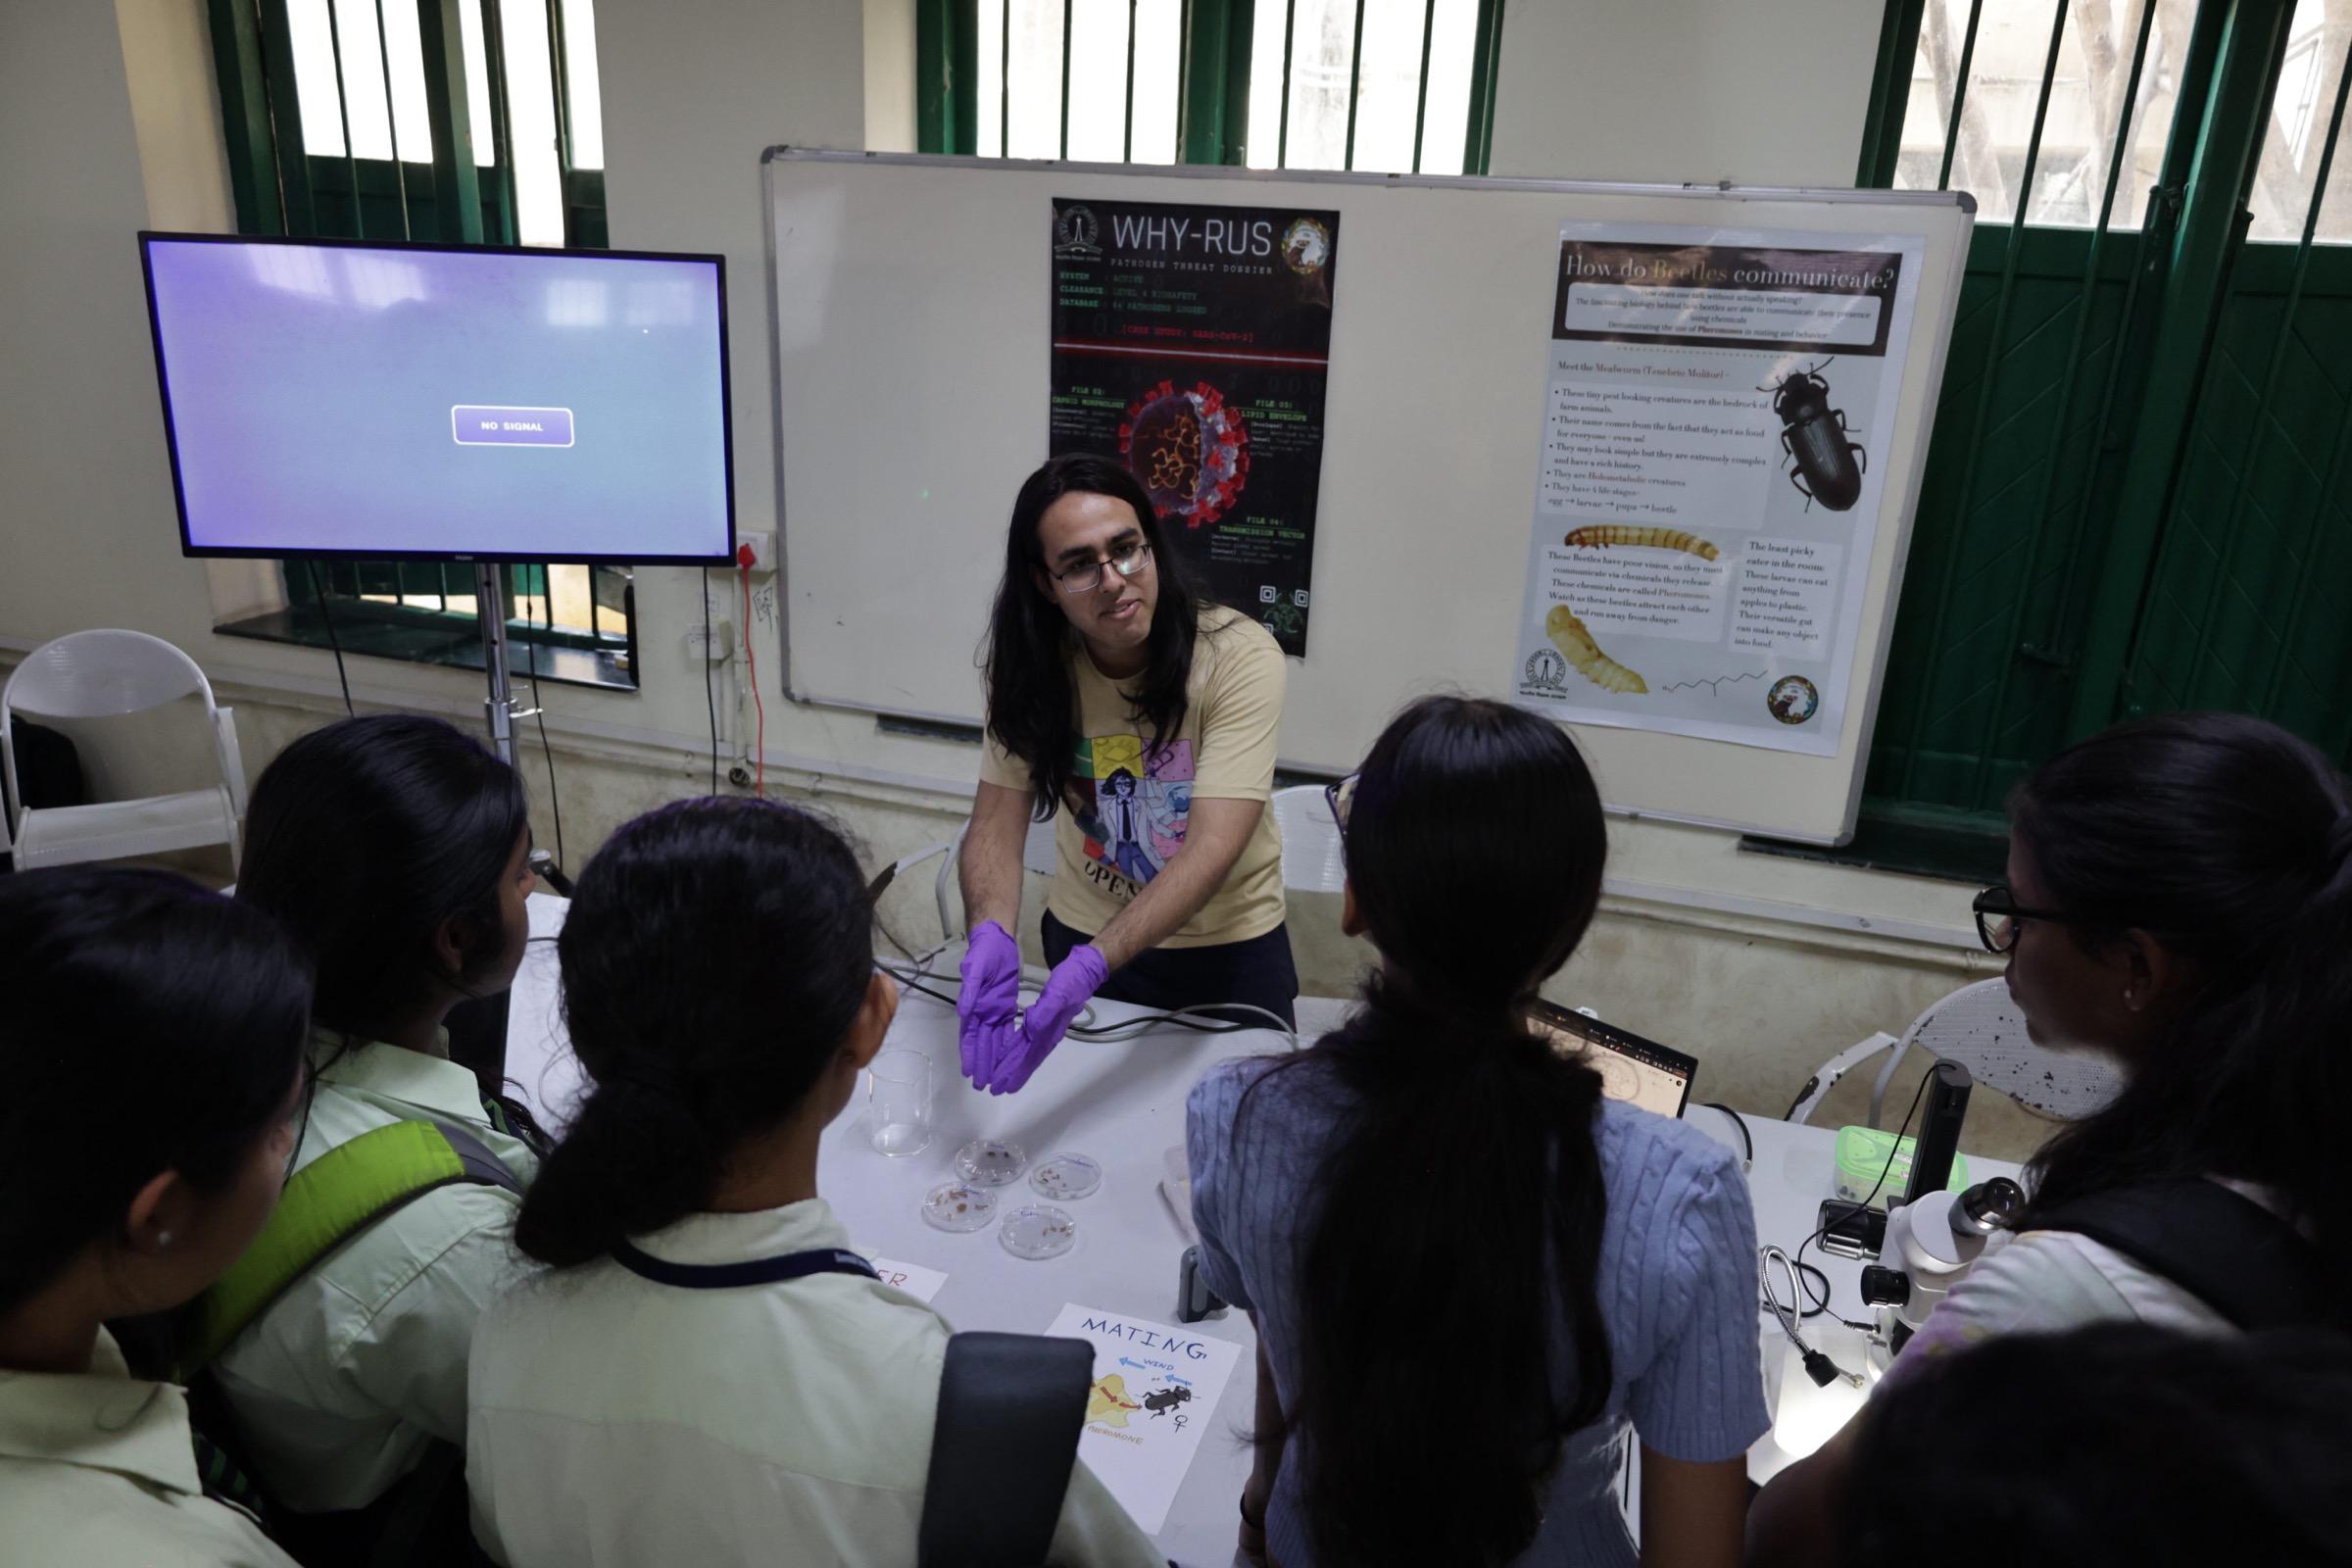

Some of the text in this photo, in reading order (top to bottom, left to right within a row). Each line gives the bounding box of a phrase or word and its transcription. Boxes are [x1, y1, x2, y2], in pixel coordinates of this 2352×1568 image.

[1112, 214, 1272, 257] WHY-RUS
[1110, 259, 1273, 275] PATHOGEN THREAT DOSSIER
[1566, 254, 1894, 289] How do Beetles communicate?
[1558, 361, 1579, 370] Meet
[1580, 363, 1593, 371] the
[1595, 364, 1641, 374] Mealworm
[1560, 402, 1579, 411] farm
[1561, 388, 1585, 398] These
[1587, 389, 1600, 400] tiny
[1602, 391, 1619, 402] pest
[1621, 392, 1651, 403] looking
[1653, 394, 1691, 404] creatures
[1708, 397, 1721, 406] the
[1723, 398, 1757, 408] bedrock
[1759, 400, 1769, 410] of
[480, 421, 544, 431] NO SIGNAL
[1558, 416, 1581, 424] Their
[1632, 420, 1652, 430] from
[1653, 421, 1666, 430] the
[1667, 422, 1683, 431] fact
[1684, 423, 1700, 432] that
[1701, 424, 1718, 436] they
[1720, 426, 1734, 435] act
[1745, 428, 1765, 437] food
[1556, 429, 1568, 438] for
[1570, 432, 1606, 441] everyone
[1556, 443, 1576, 454] They
[1577, 446, 1592, 455] may
[1594, 445, 1612, 454] look
[1614, 446, 1640, 458] simple
[1642, 448, 1655, 457] but
[1656, 450, 1673, 460] they
[1690, 452, 1730, 464] extremely
[1554, 457, 1643, 471] and have rich history.
[1553, 468, 1571, 479] They
[1588, 471, 1646, 483] Holometabolic
[1647, 477, 1686, 487] creatures
[1552, 482, 1570, 493] They
[1598, 486, 1611, 495] life
[1548, 498, 1677, 514] egg larvae pupa beetle
[1749, 540, 1815, 558] The least picky
[1547, 551, 1572, 561] These
[1573, 554, 1601, 564] Beetles
[1623, 559, 1643, 567] poor
[1644, 562, 1671, 570] vision,
[1684, 564, 1700, 573] they
[1782, 560, 1796, 568] the
[1552, 566, 1607, 578] communicate
[1621, 572, 1662, 583] chemicals
[1663, 575, 1680, 586] they
[1744, 570, 1769, 579] These
[1771, 572, 1797, 582] larvae
[1551, 578, 1575, 588] These
[1577, 581, 1616, 592] chemicals
[1632, 586, 1657, 596] called
[1742, 585, 1800, 597] anything from
[1548, 591, 1575, 602] Watch
[1587, 595, 1607, 604] these
[1609, 598, 1637, 608] beetles
[1639, 601, 1665, 610] attract
[1667, 603, 1686, 612] each
[1688, 605, 1710, 613] other
[1740, 598, 1768, 608] apples
[1574, 608, 1589, 616] and
[1605, 612, 1627, 621] away
[1628, 612, 1647, 621] from
[1739, 610, 1761, 619] Their
[1763, 614, 1797, 624] versatile
[1752, 626, 1775, 635] make
[1735, 637, 1751, 646] into
[1081, 1315, 1208, 1360] MATING
[1143, 1357, 1175, 1372] WIND
